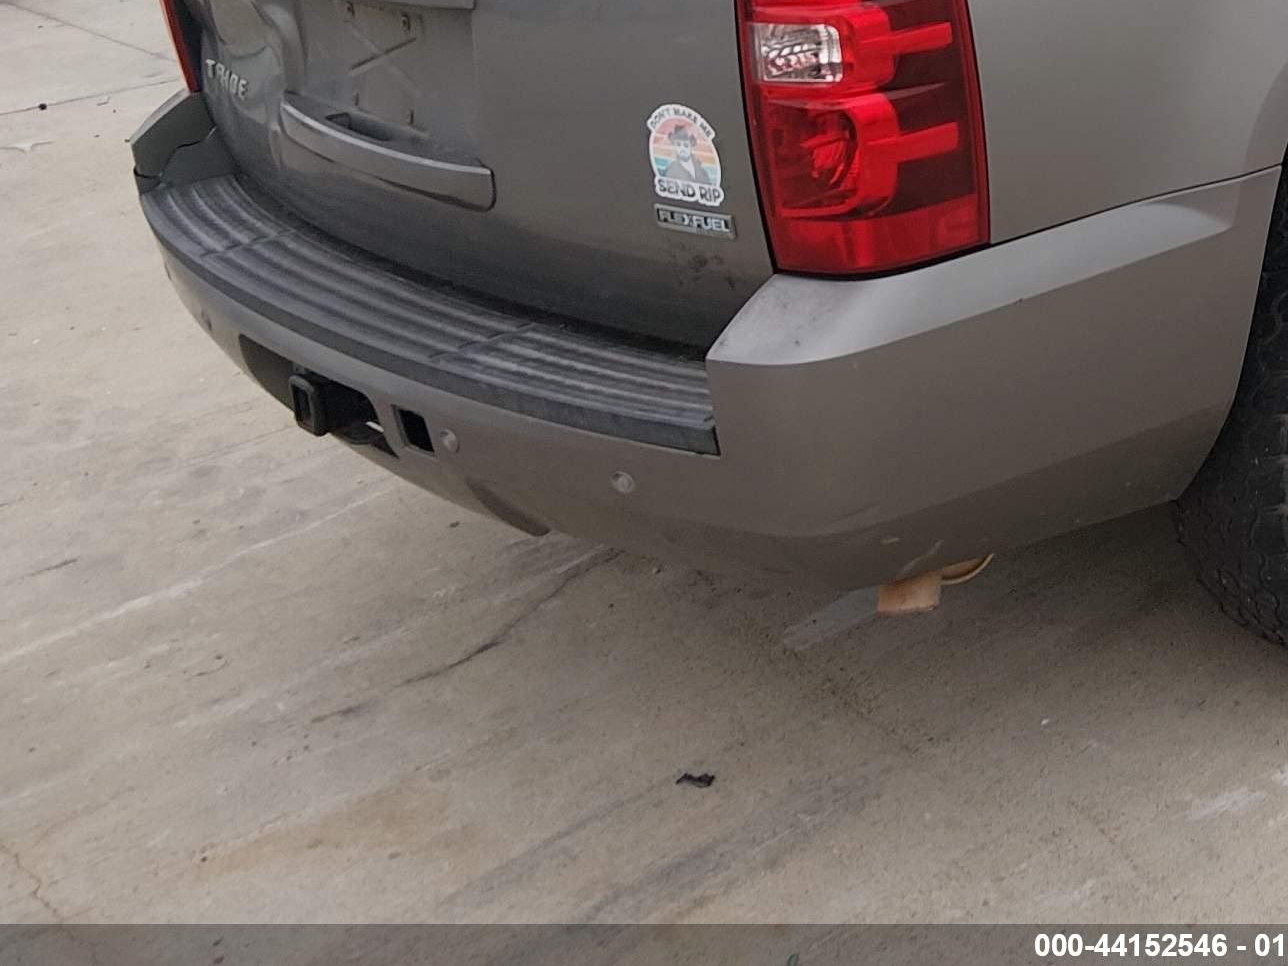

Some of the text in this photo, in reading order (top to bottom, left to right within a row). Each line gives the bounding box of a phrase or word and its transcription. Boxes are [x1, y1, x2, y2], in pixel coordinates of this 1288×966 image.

[205, 58, 249, 101] TAHOE
[649, 107, 713, 138] DON'T MAKE ME
[657, 178, 722, 203] SEND RIP
